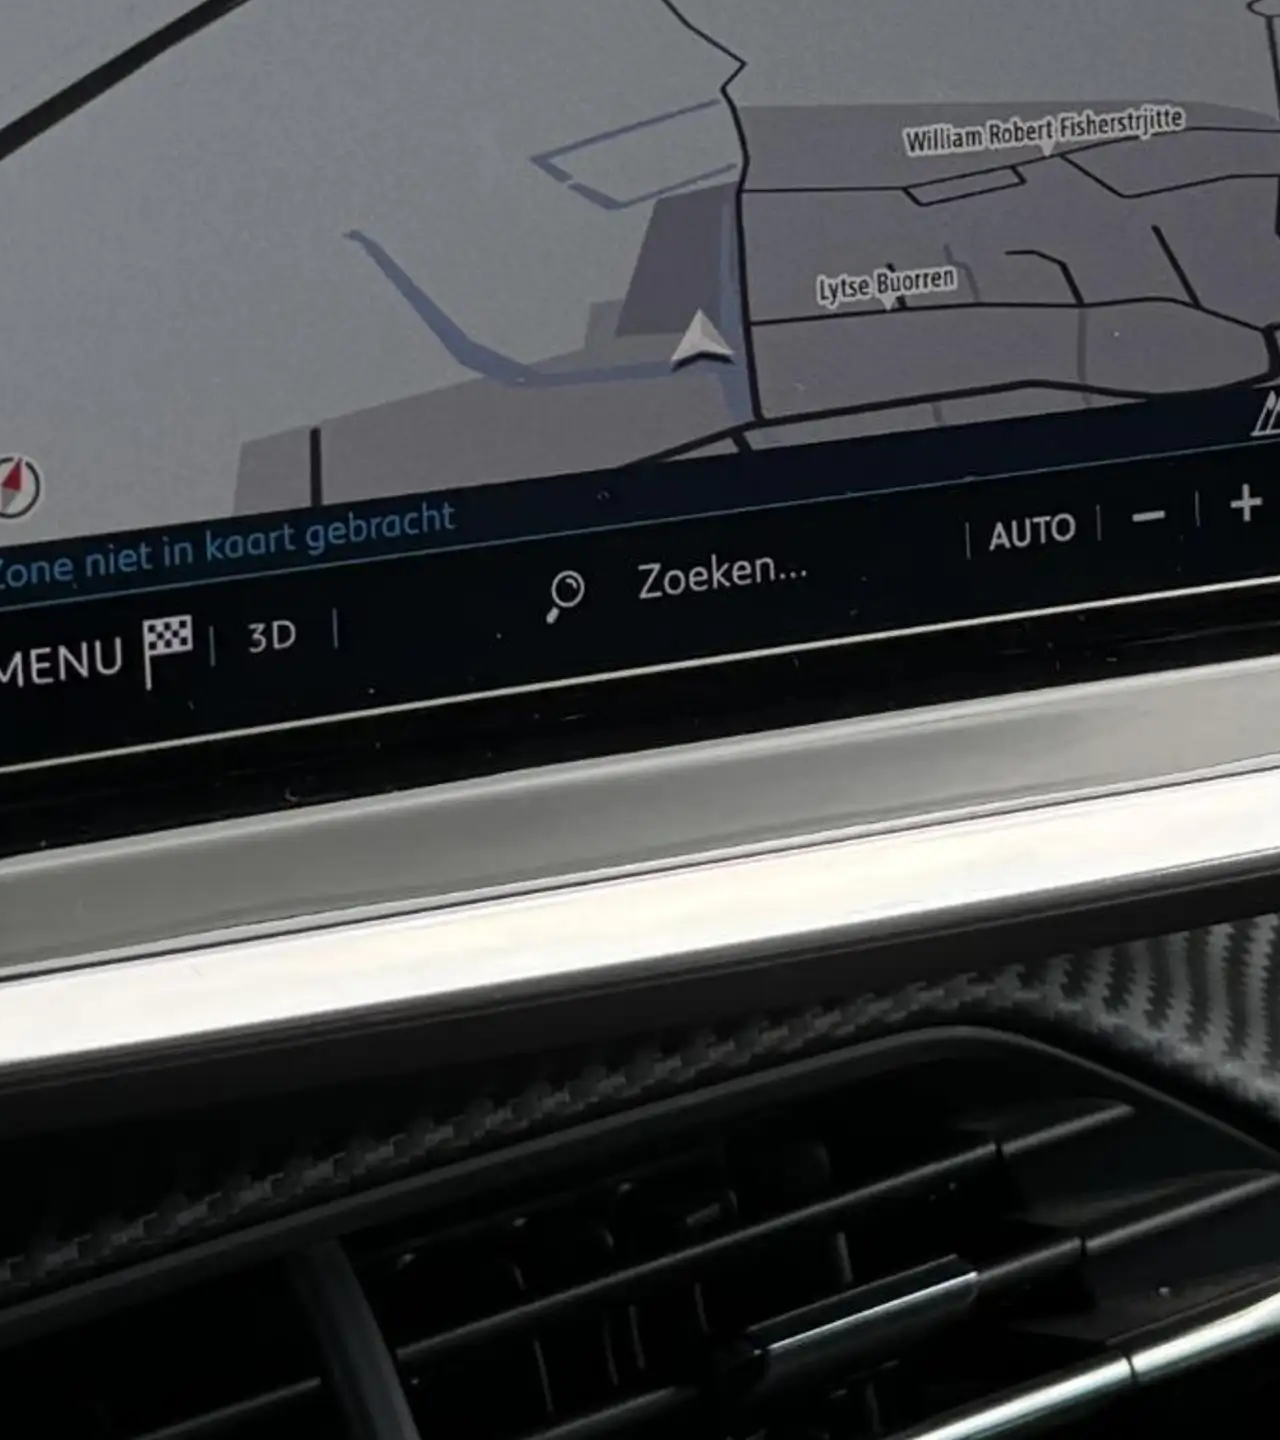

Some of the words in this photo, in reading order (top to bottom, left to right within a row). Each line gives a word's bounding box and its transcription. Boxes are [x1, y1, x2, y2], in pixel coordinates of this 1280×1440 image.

[906, 128, 983, 153] William
[989, 120, 1053, 145] Robert
[1060, 107, 1183, 139] Fisherstrjitte
[820, 278, 870, 306] Lytse
[876, 269, 955, 294] Buorren
[85, 542, 153, 580] niet
[162, 535, 194, 569] in
[204, 526, 295, 561] kaart
[304, 501, 457, 557] gebracht
[988, 512, 1077, 552] AUTO
[636, 552, 808, 600] Zoeken...
[247, 619, 298, 654] 3D
